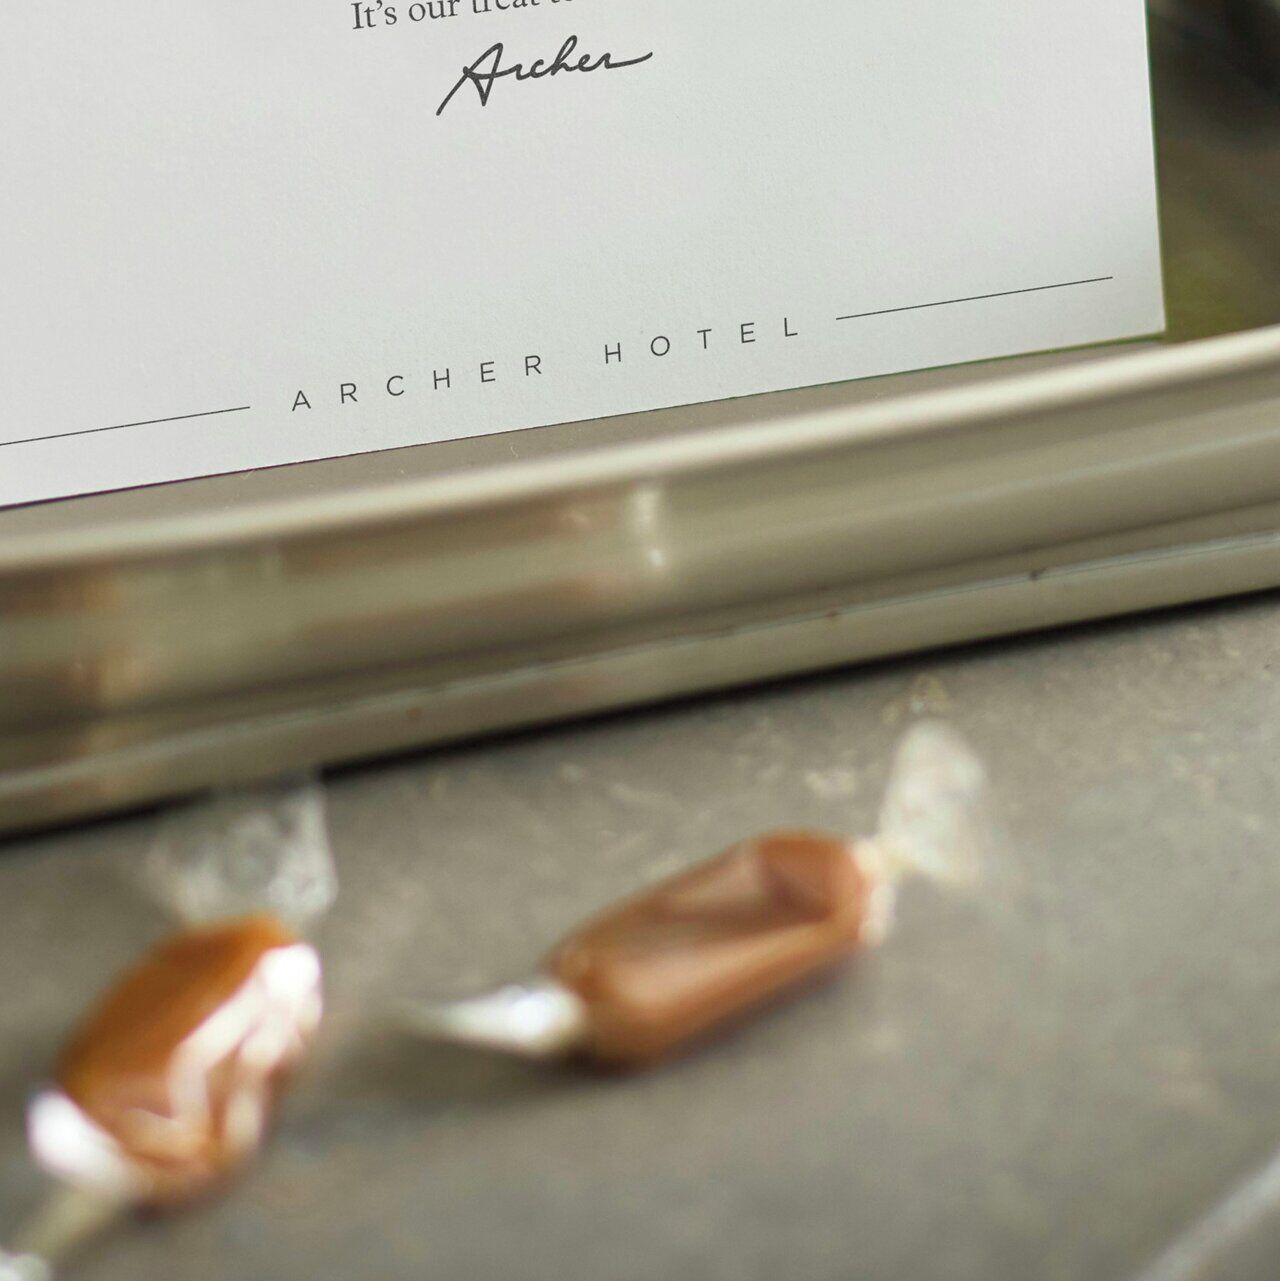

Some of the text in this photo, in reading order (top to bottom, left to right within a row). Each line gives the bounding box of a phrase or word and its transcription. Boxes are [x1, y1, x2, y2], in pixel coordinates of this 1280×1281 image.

[350, 0, 398, 30] It's
[435, 34, 654, 117] Archer
[291, 317, 799, 412] ARCHER HOTEL
